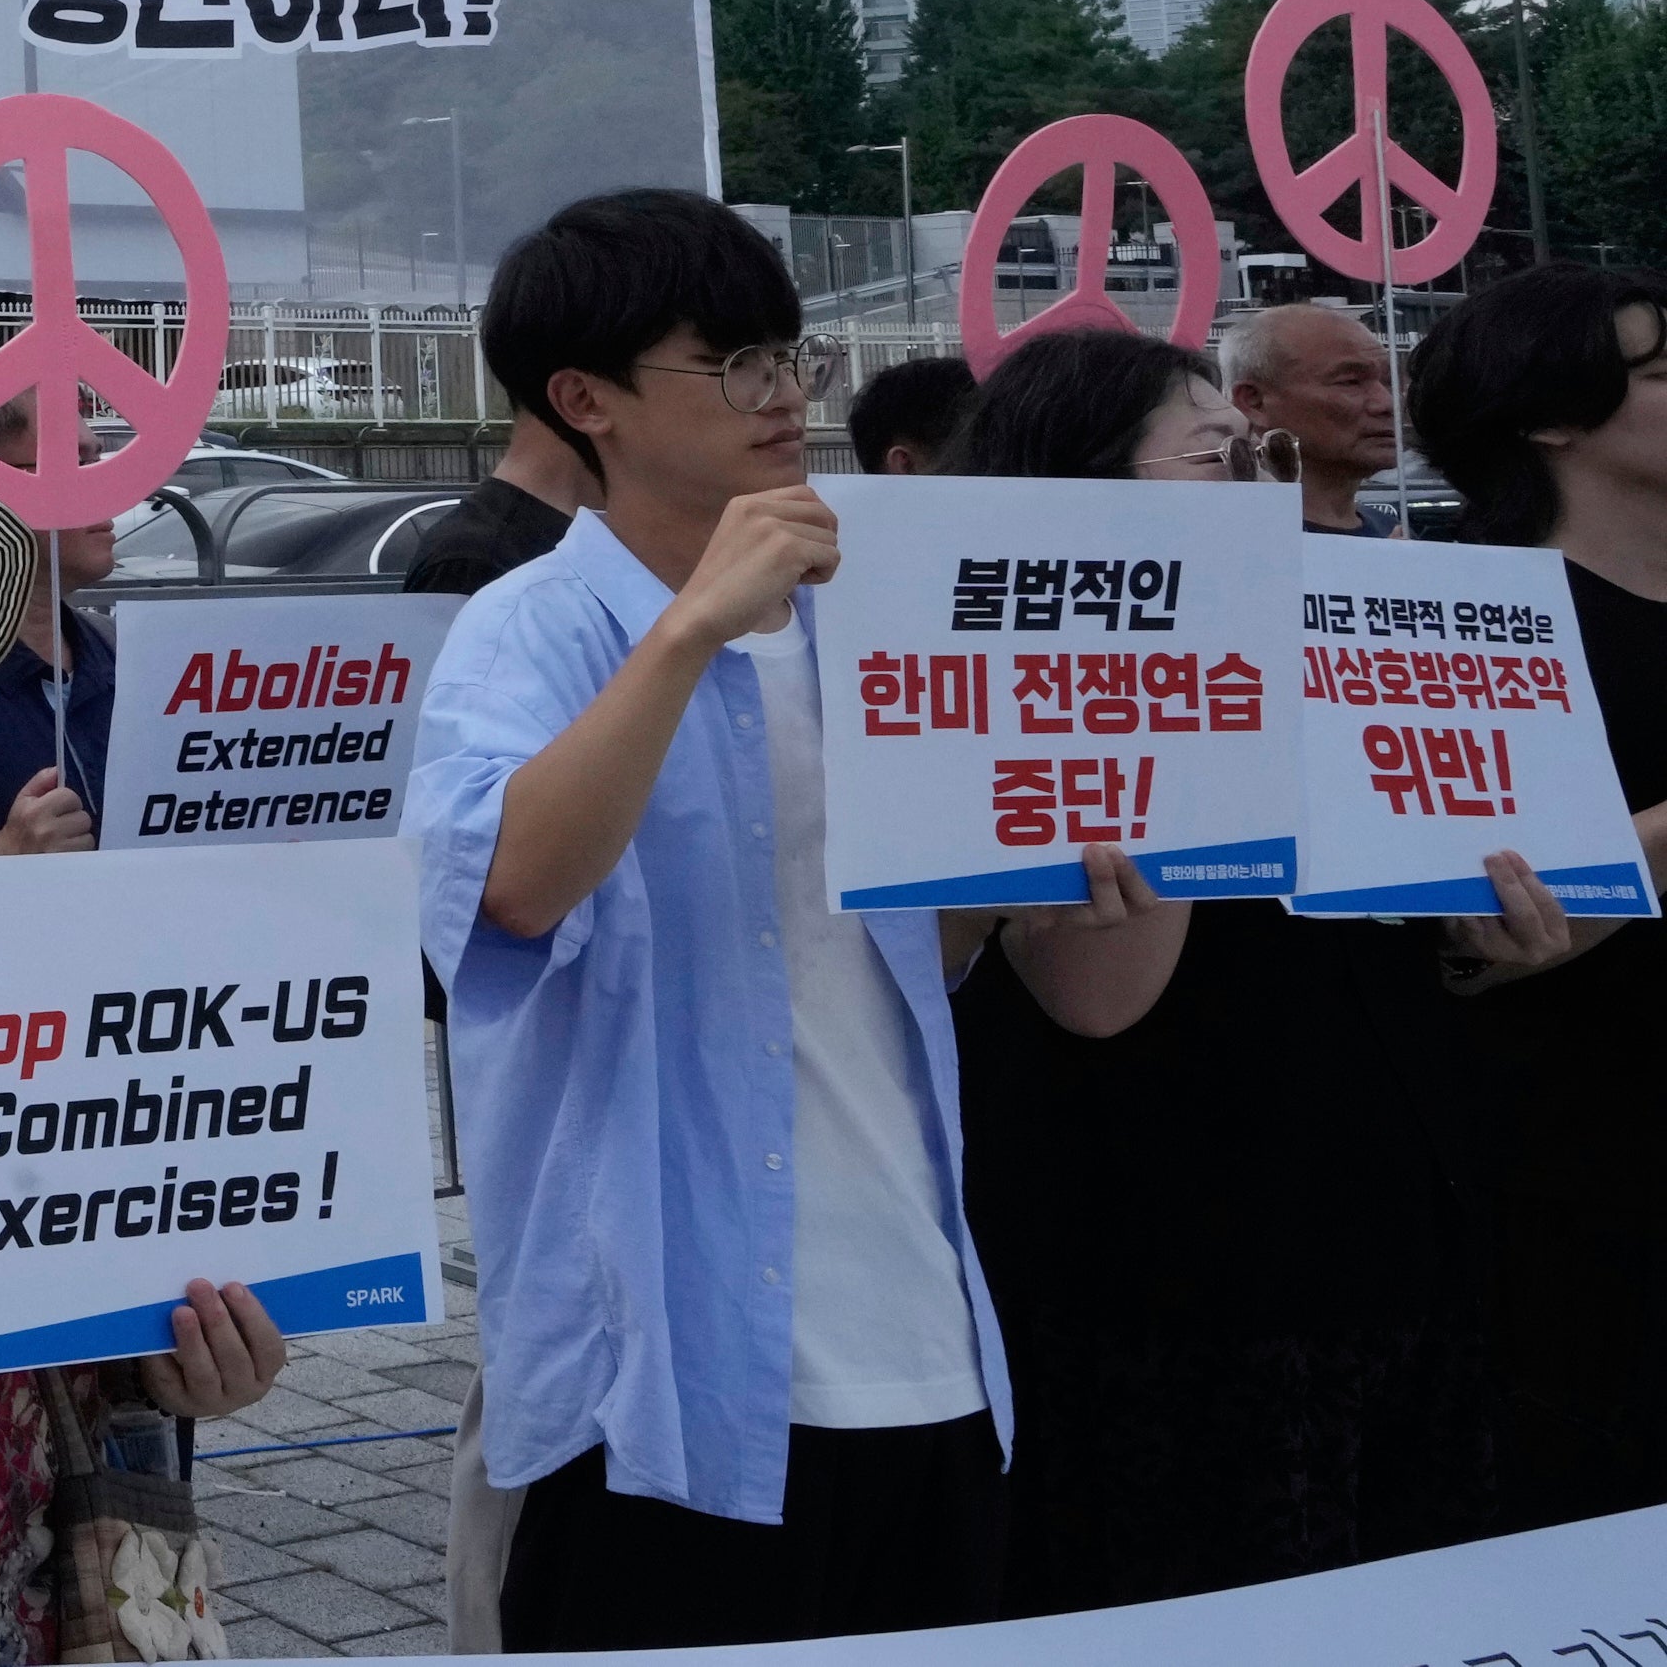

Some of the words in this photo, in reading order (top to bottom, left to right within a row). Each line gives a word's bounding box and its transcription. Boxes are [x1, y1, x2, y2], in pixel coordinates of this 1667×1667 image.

[951, 559, 1182, 631] 불법적인
[1364, 597, 1446, 640] 전략적
[1454, 601, 1554, 645] 유연성은
[163, 643, 411, 715] Abolish
[859, 651, 989, 736] 한미
[1012, 651, 1263, 735] 전쟁연습
[176, 719, 394, 773] Extended
[1362, 724, 1516, 817] 위반!
[138, 788, 393, 837] Deterrence
[992, 756, 1155, 847] 중단!
[84, 975, 369, 1058] ROK-US
[345, 1285, 405, 1308] SPARK
